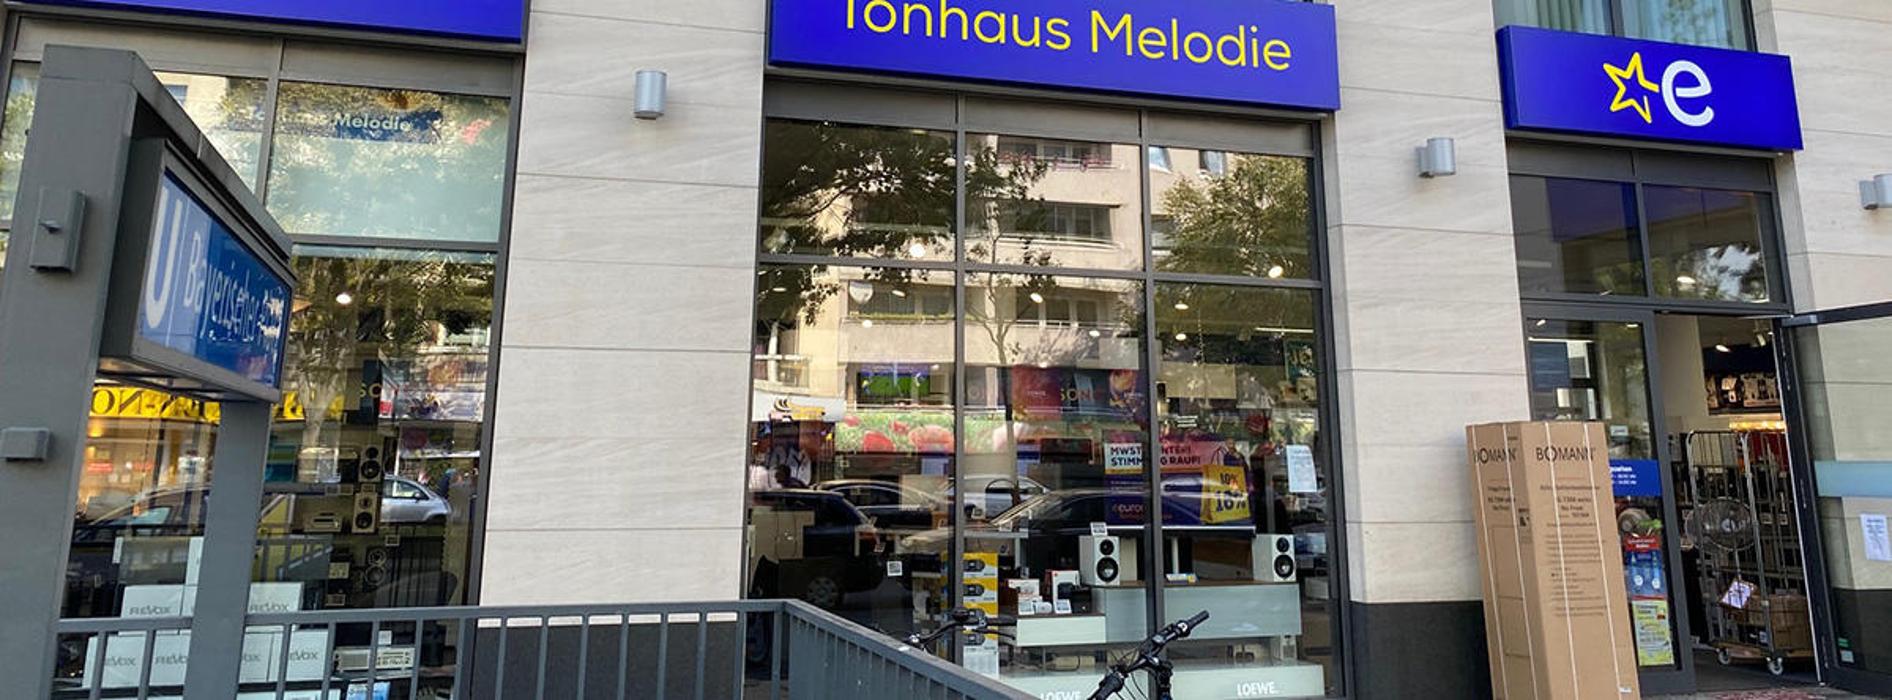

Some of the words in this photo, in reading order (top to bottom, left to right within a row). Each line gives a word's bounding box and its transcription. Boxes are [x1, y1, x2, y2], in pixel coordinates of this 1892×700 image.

[1091, 10, 1292, 71] Melodie
[1661, 60, 1715, 127] e
[145, 186, 183, 329] U
[1535, 446, 1595, 462] BOMANN
